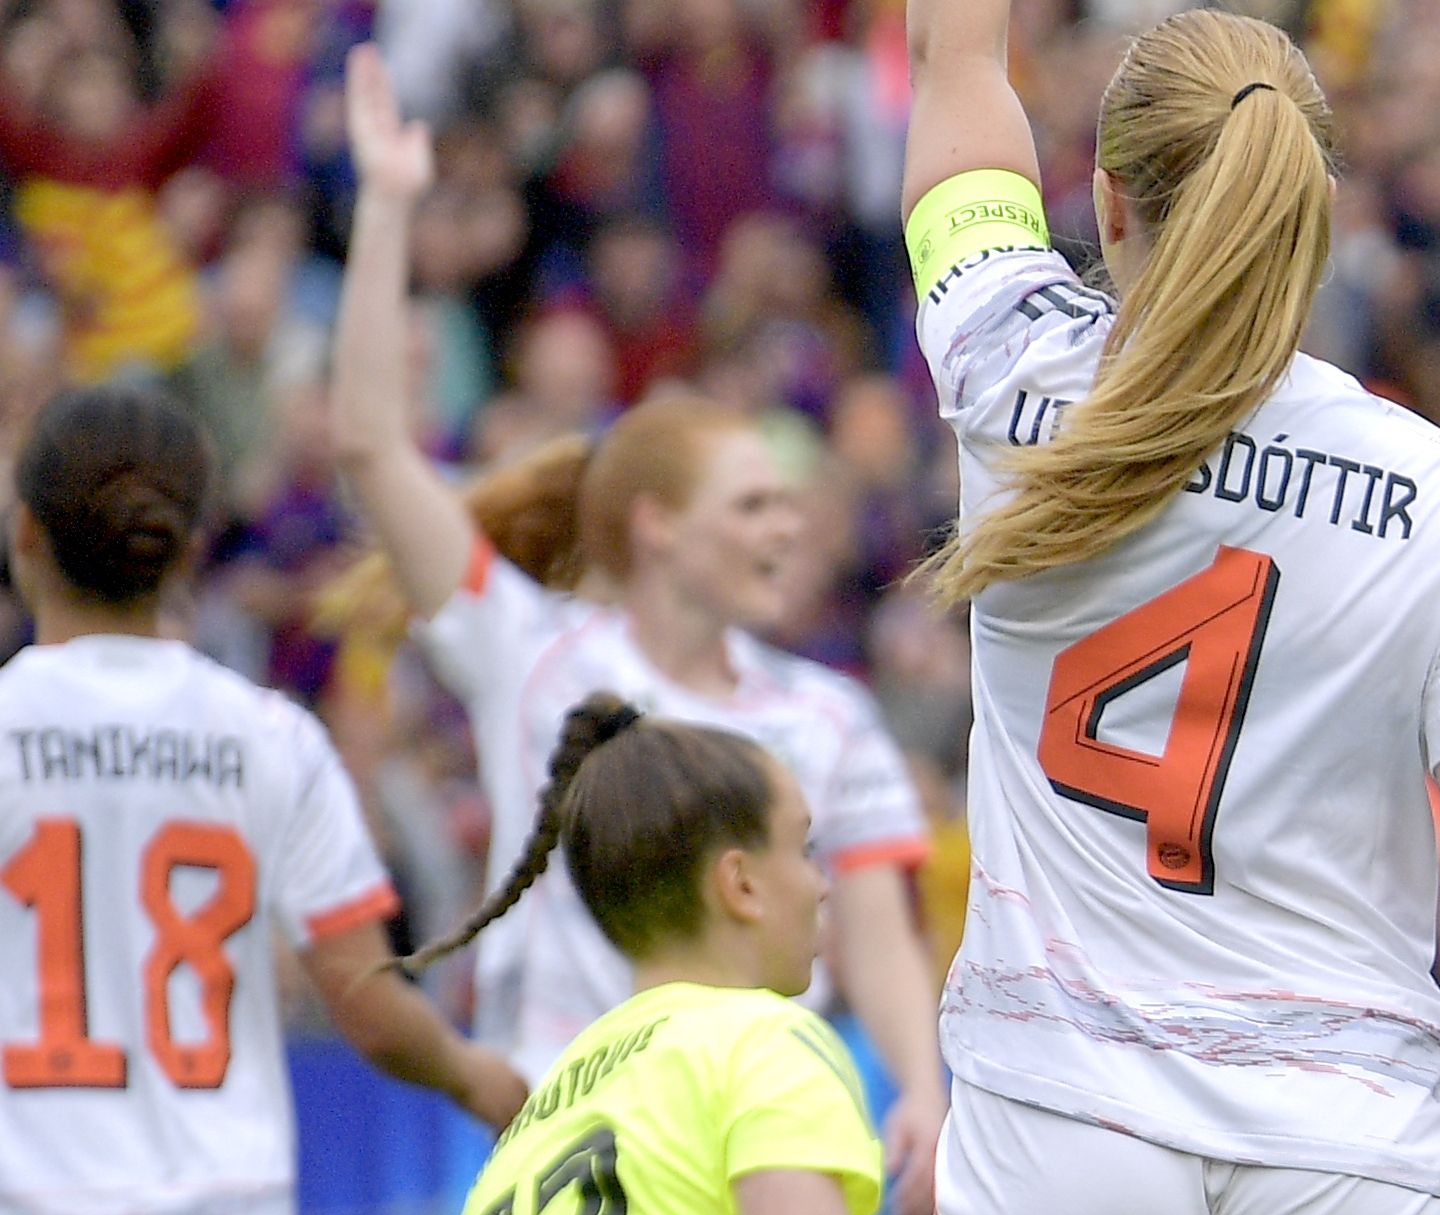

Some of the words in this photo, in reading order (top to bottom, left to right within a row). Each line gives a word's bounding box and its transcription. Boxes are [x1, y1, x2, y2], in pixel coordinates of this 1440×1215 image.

[950, 203, 1041, 234] RESPECT
[8, 724, 246, 788] TANIKAWA
[1037, 543, 1281, 896] 4
[0, 816, 259, 1091] 18
